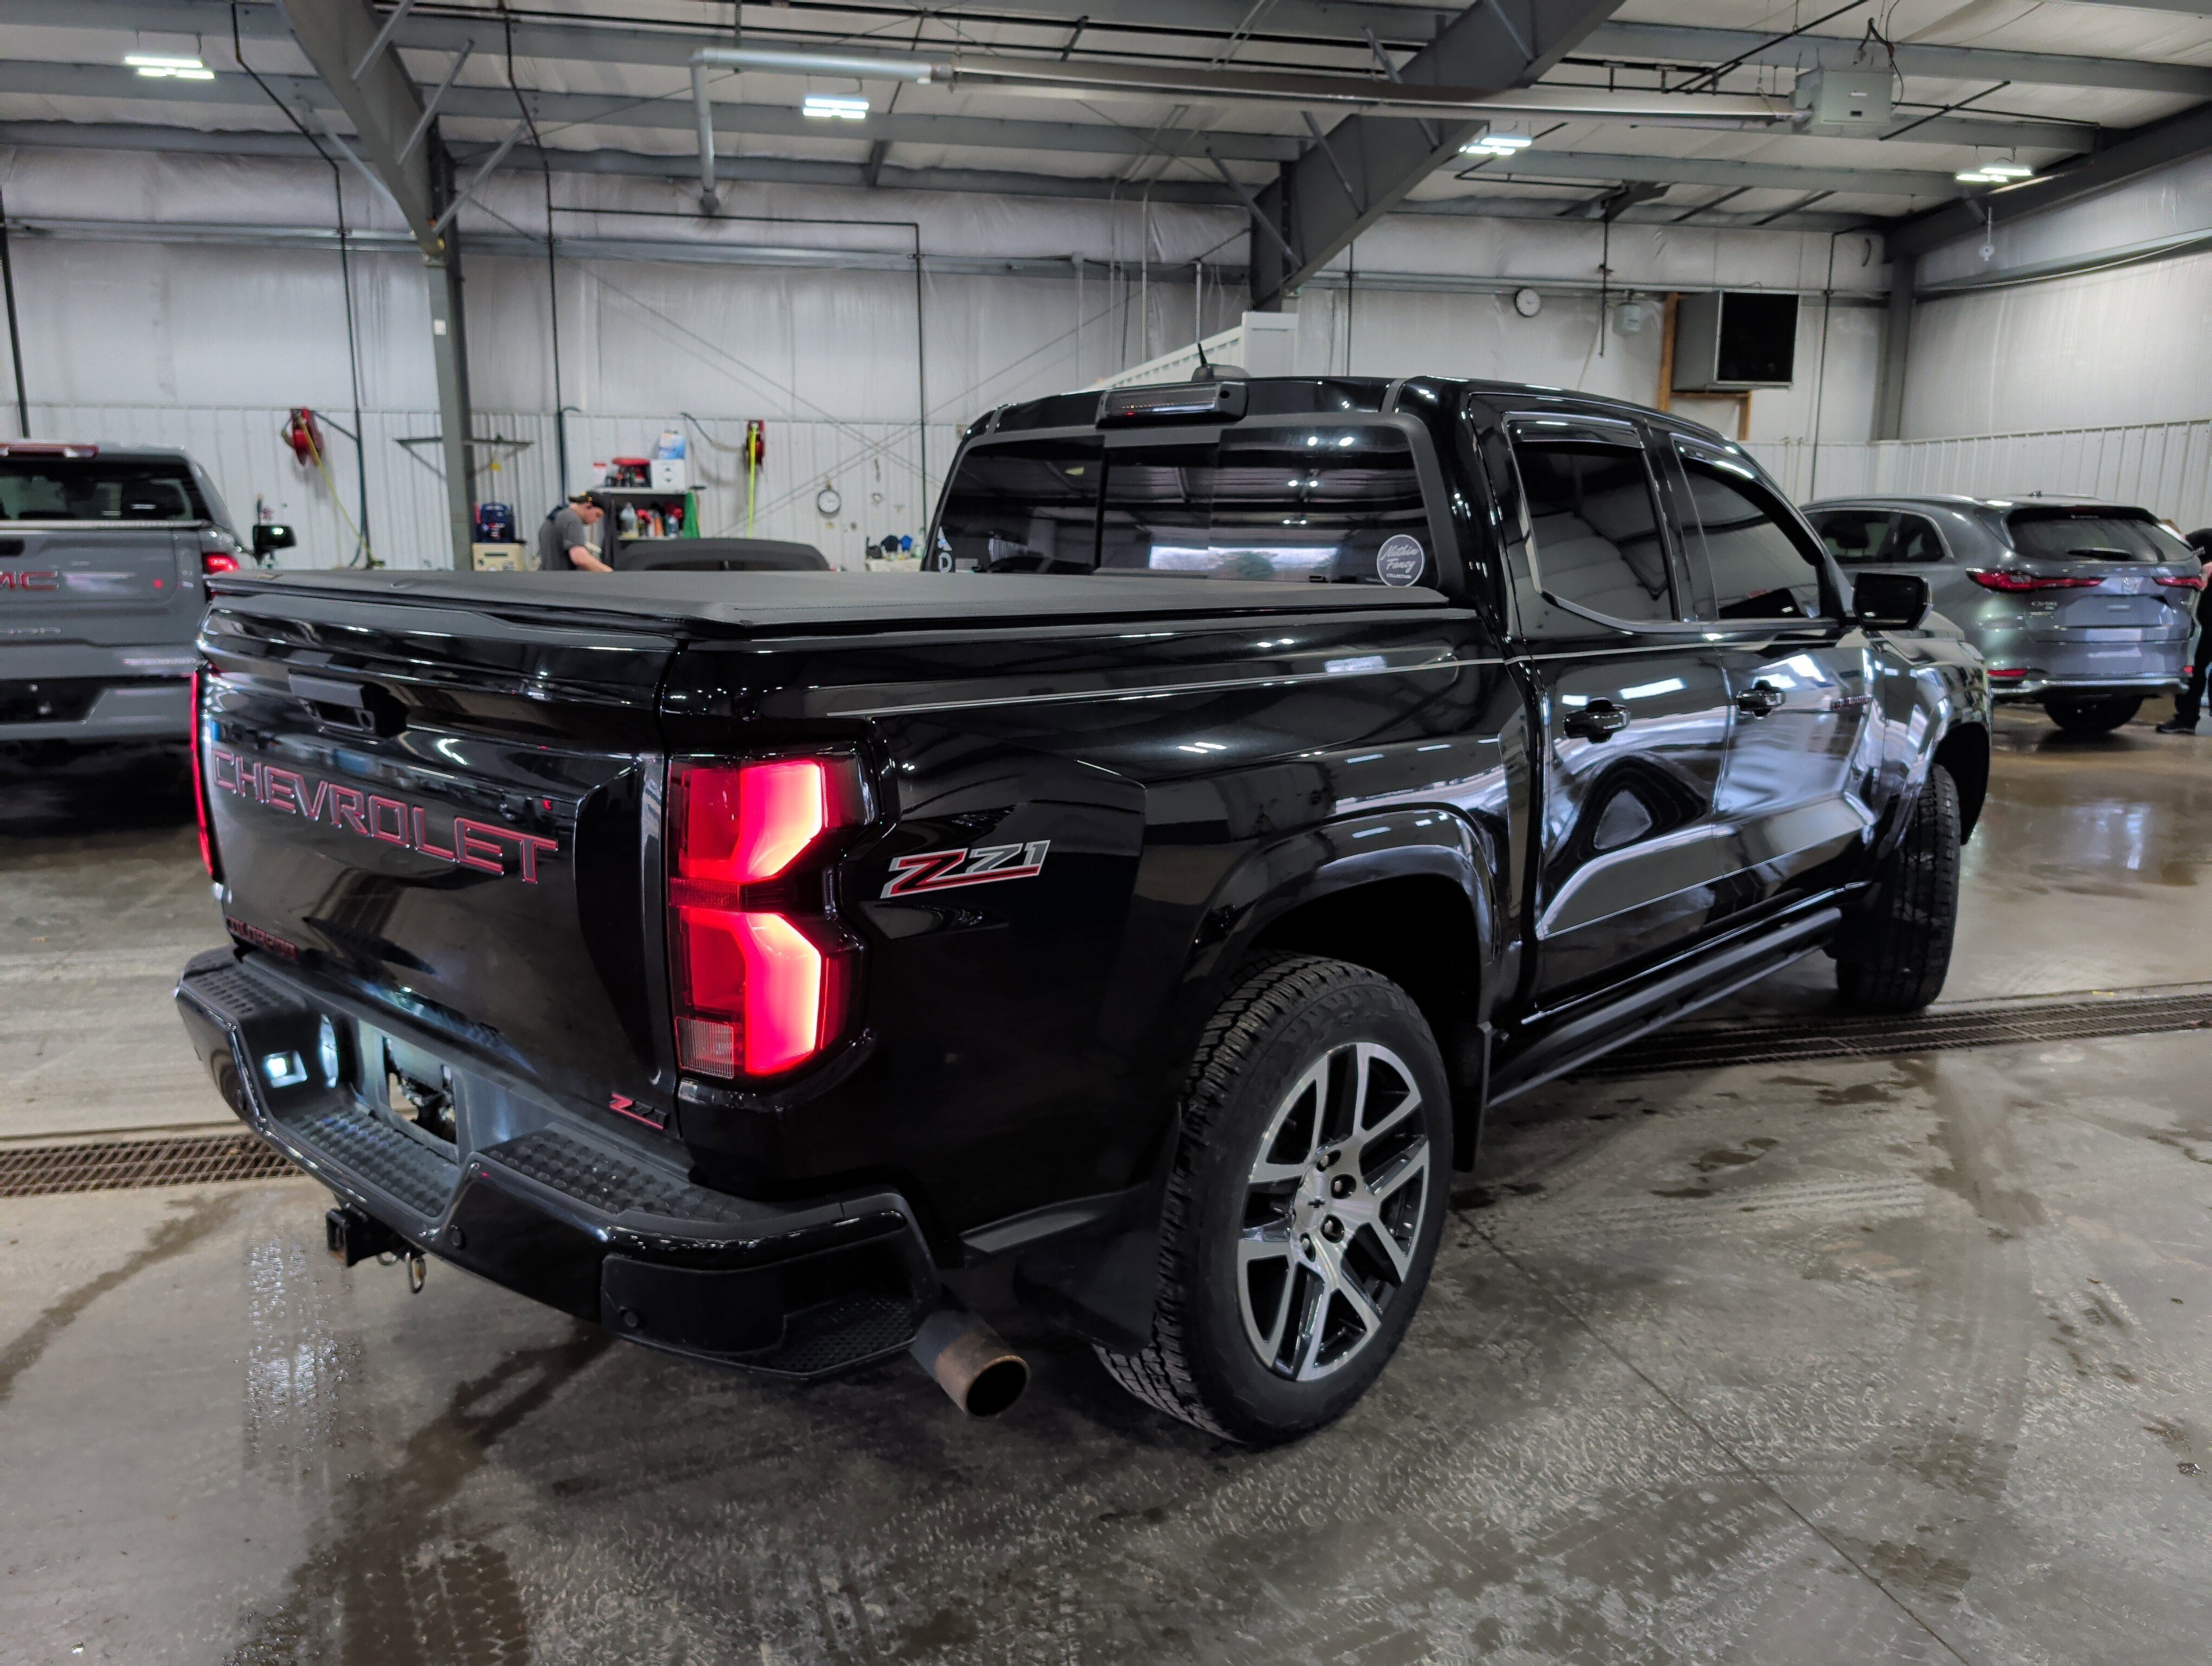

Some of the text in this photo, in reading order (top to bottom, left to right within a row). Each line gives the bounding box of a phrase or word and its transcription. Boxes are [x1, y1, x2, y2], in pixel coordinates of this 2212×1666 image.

[1386, 558, 1417, 574] Fancy
[212, 749, 558, 884] CHEVROLET
[880, 840, 1051, 899] Z71
[608, 1091, 670, 1130] Z71
